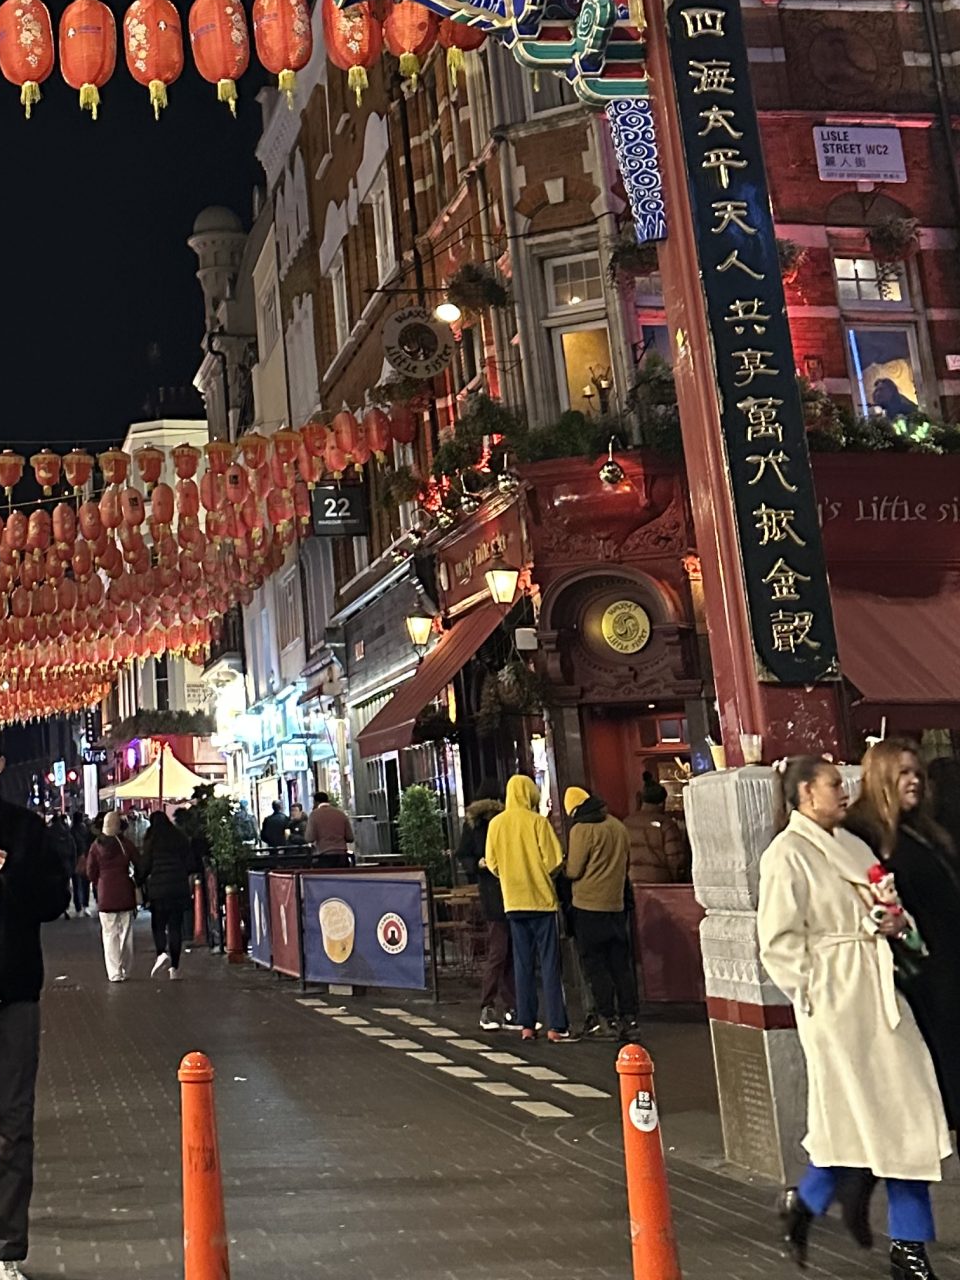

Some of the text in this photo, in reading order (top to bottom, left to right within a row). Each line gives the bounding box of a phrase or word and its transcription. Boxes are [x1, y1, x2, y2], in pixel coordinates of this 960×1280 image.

[821, 131, 850, 141] LISLE
[822, 143, 889, 155] STREET WC2
[324, 497, 351, 518] 22
